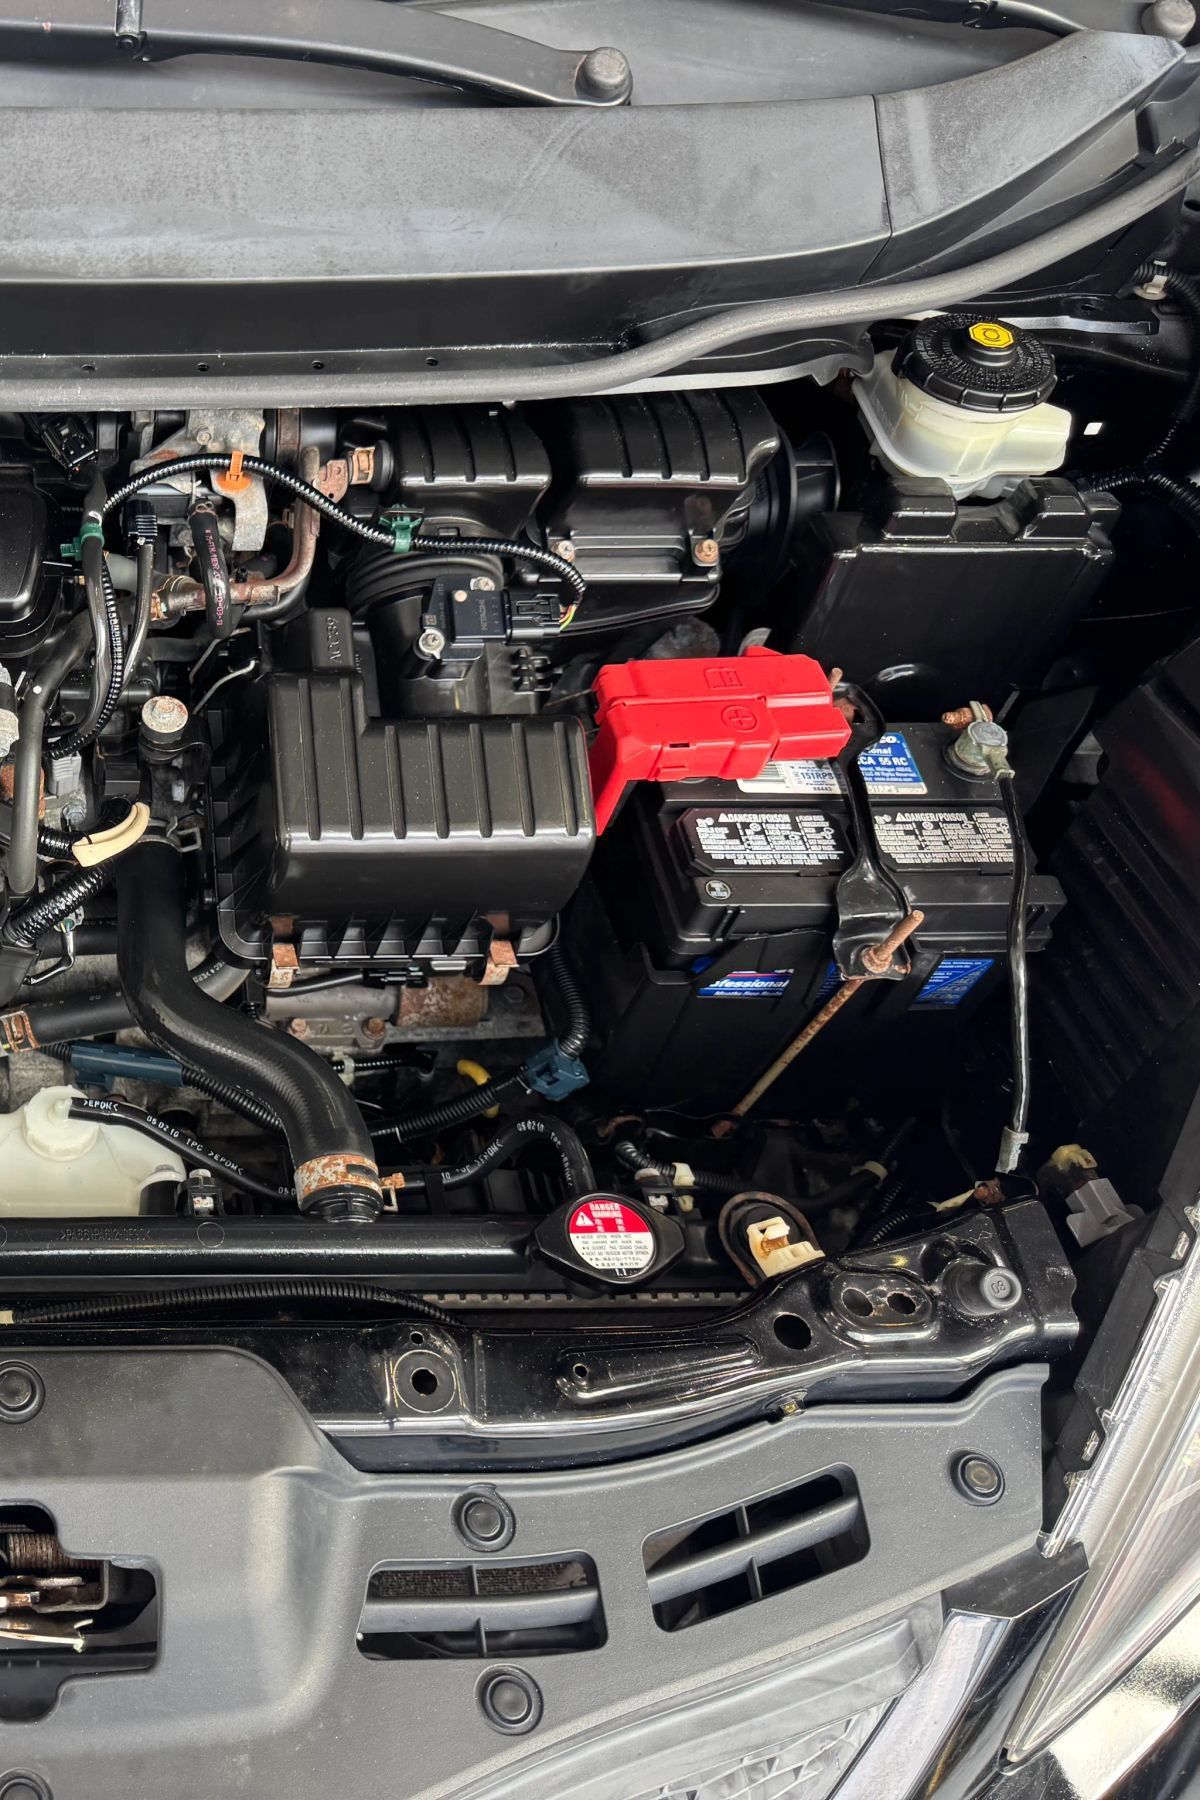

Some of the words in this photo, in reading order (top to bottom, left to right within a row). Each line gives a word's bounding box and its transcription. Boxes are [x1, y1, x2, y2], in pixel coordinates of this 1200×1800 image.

[858, 757, 876, 765] CA
[892, 757, 908, 766] RC
[728, 813, 791, 822] DANGER/POISON
[905, 812, 968, 822] DANGER/POISON
[589, 1203, 620, 1211] DANGER
